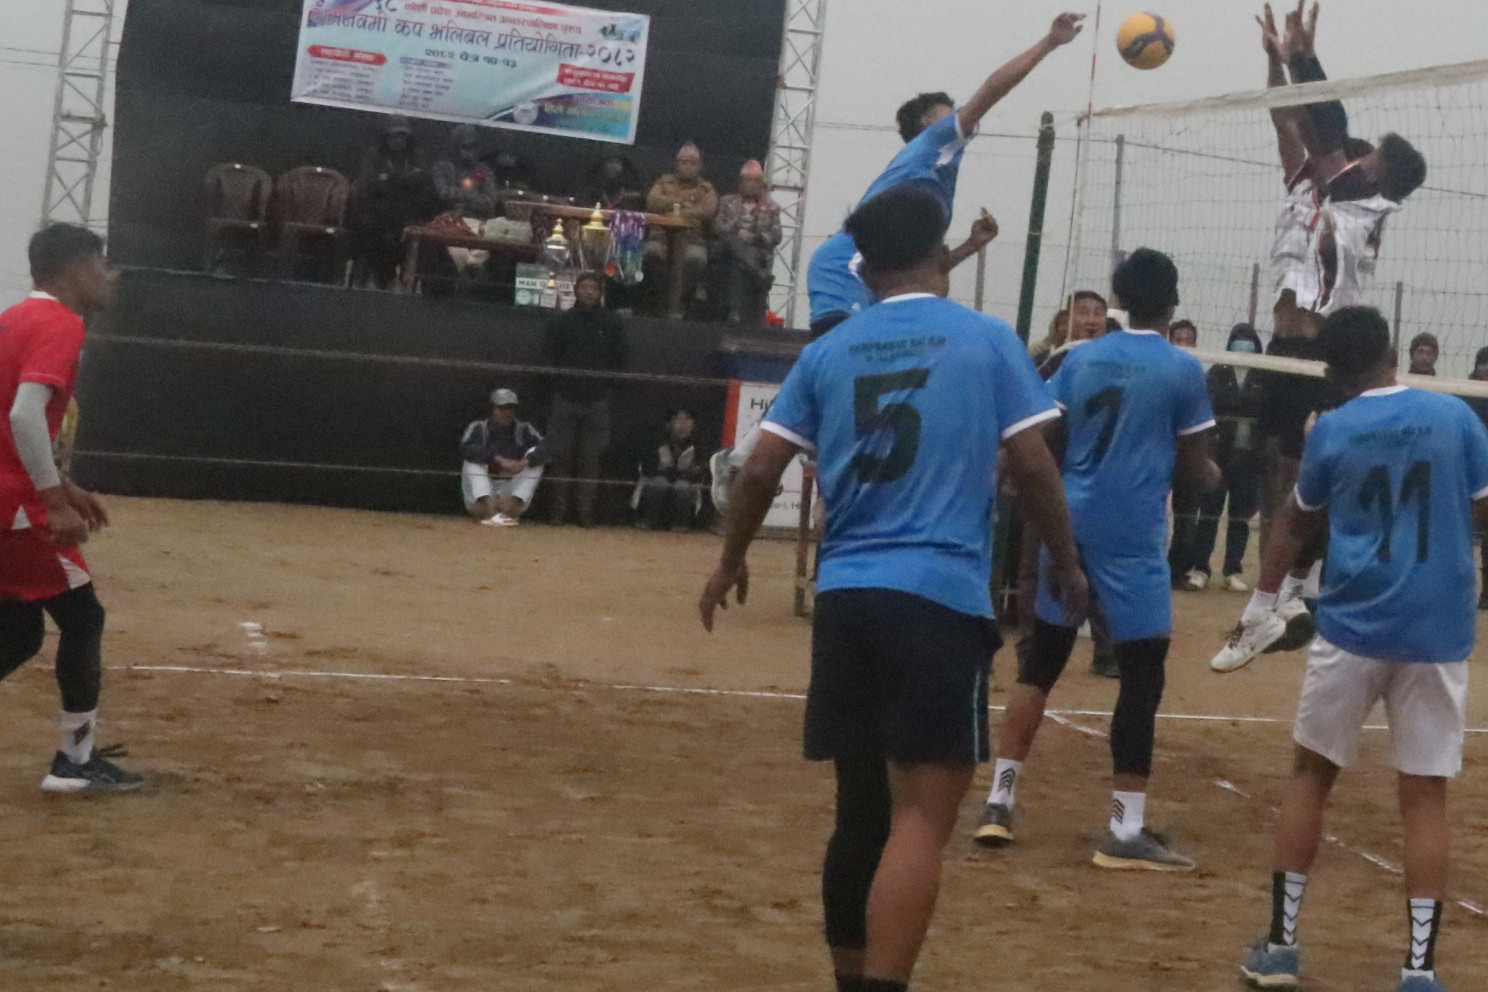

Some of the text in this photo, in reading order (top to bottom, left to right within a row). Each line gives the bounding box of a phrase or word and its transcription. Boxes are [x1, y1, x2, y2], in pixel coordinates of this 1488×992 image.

[394, 18, 426, 38] कप
[429, 19, 492, 48] भलिबल
[518, 279, 537, 287] MAN
[850, 367, 930, 484] 5
[1358, 460, 1432, 563] 11
